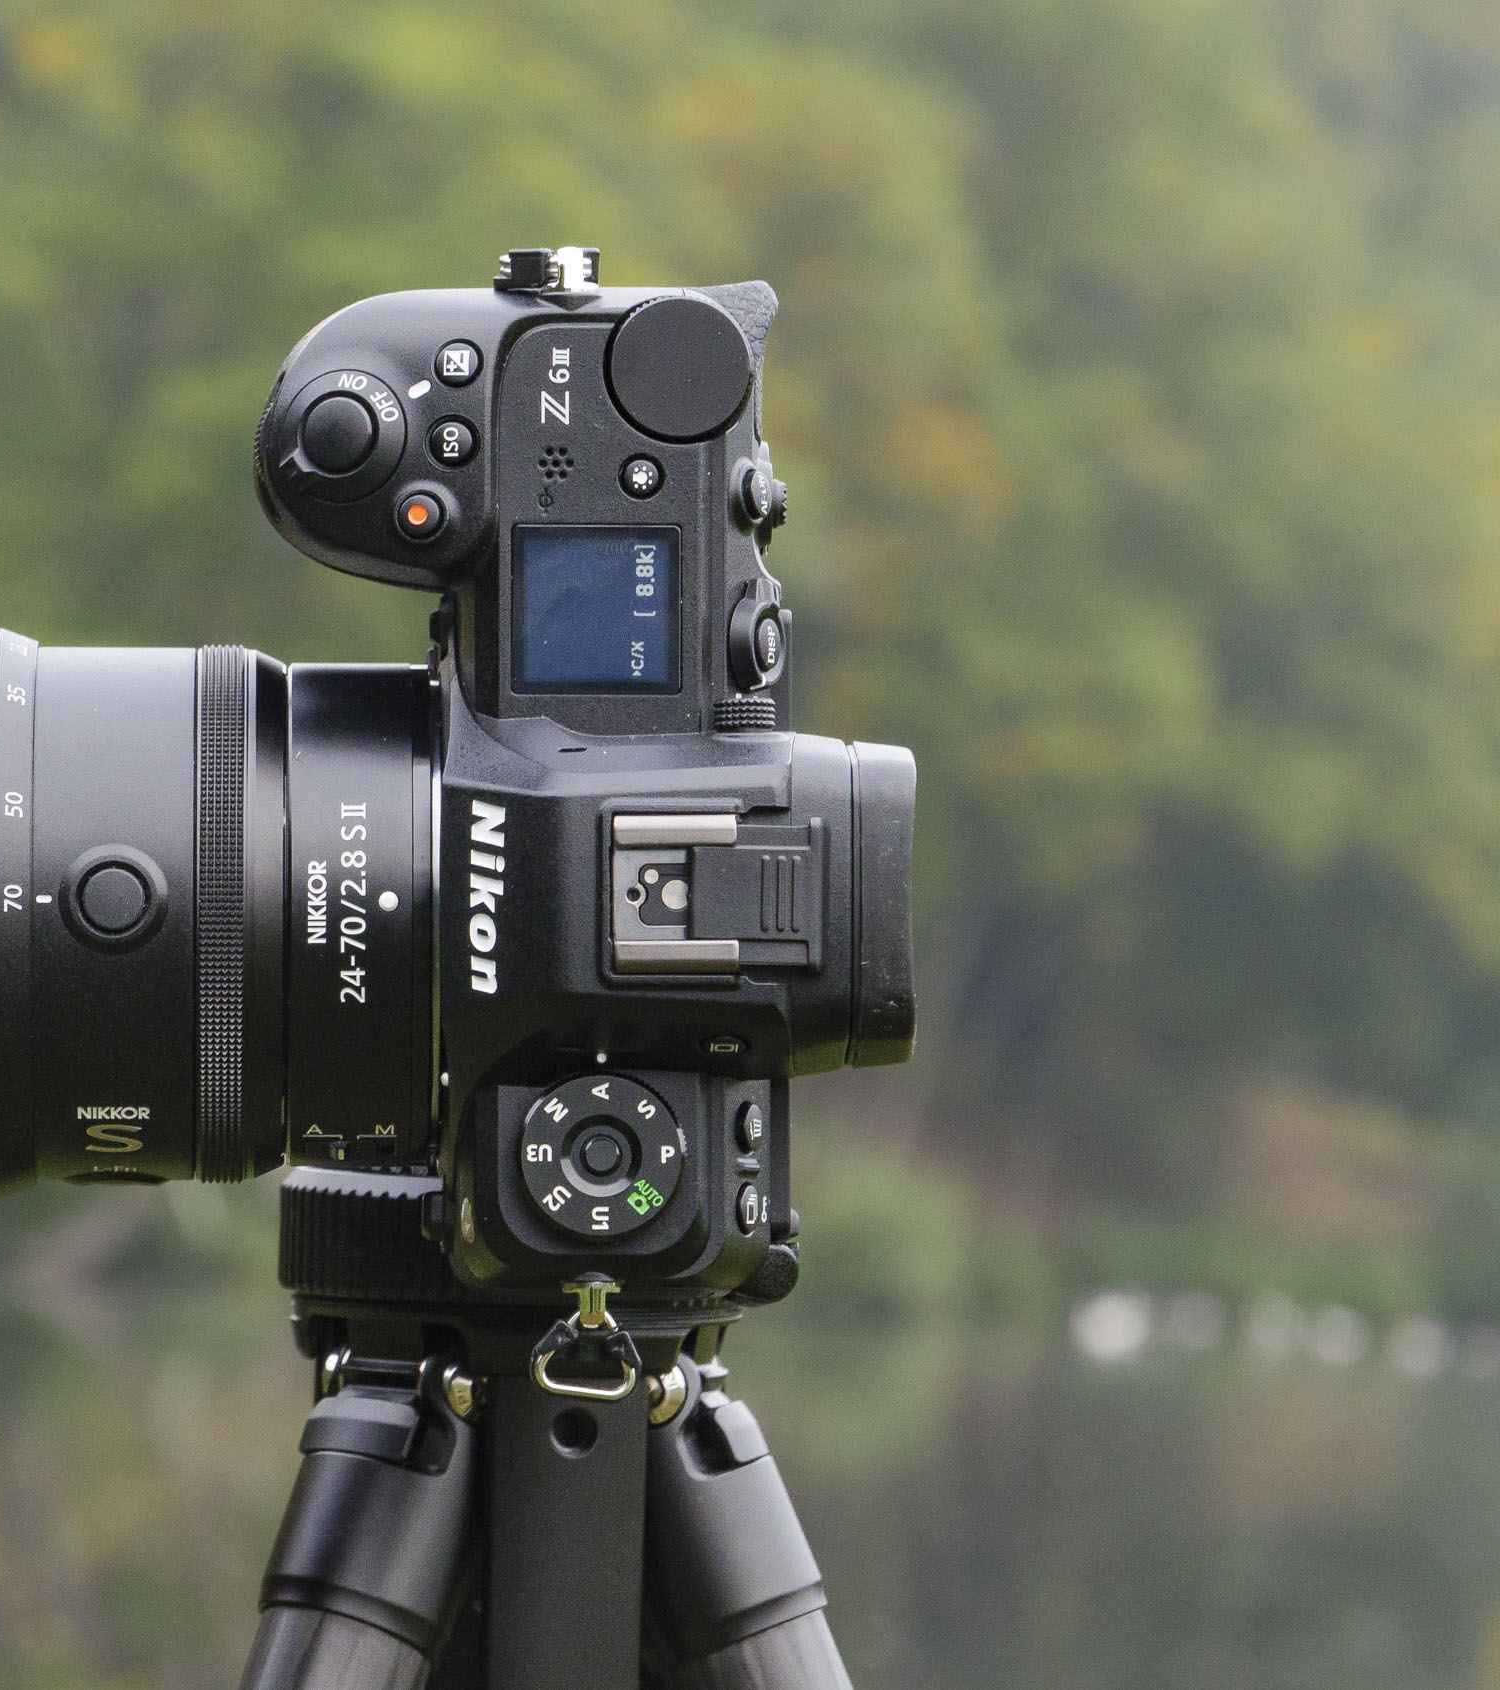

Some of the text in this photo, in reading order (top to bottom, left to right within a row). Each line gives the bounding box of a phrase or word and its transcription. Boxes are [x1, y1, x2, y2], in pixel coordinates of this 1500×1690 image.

[338, 373, 368, 391] ON
[369, 391, 399, 422] OFF
[443, 426, 459, 458] ISO
[767, 625, 776, 664] DISP
[6, 683, 26, 706] 35
[4, 791, 24, 818] 50
[3, 884, 23, 912] 70
[307, 860, 327, 944] NIKKOR
[340, 801, 366, 1004] 24-70/2.8 S II
[469, 799, 506, 995] Nikon
[591, 1082, 610, 1100] A
[77, 1106, 150, 1120] NIKKOR
[543, 1097, 569, 1123] M
[637, 1099, 657, 1120] S
[85, 1124, 143, 1152] S
[306, 1123, 394, 1135] A M
[526, 1143, 553, 1162] U3
[660, 1145, 675, 1164] P
[542, 1185, 572, 1212] U2
[633, 1178, 664, 1207] AUTO
[591, 1206, 610, 1231] U1
